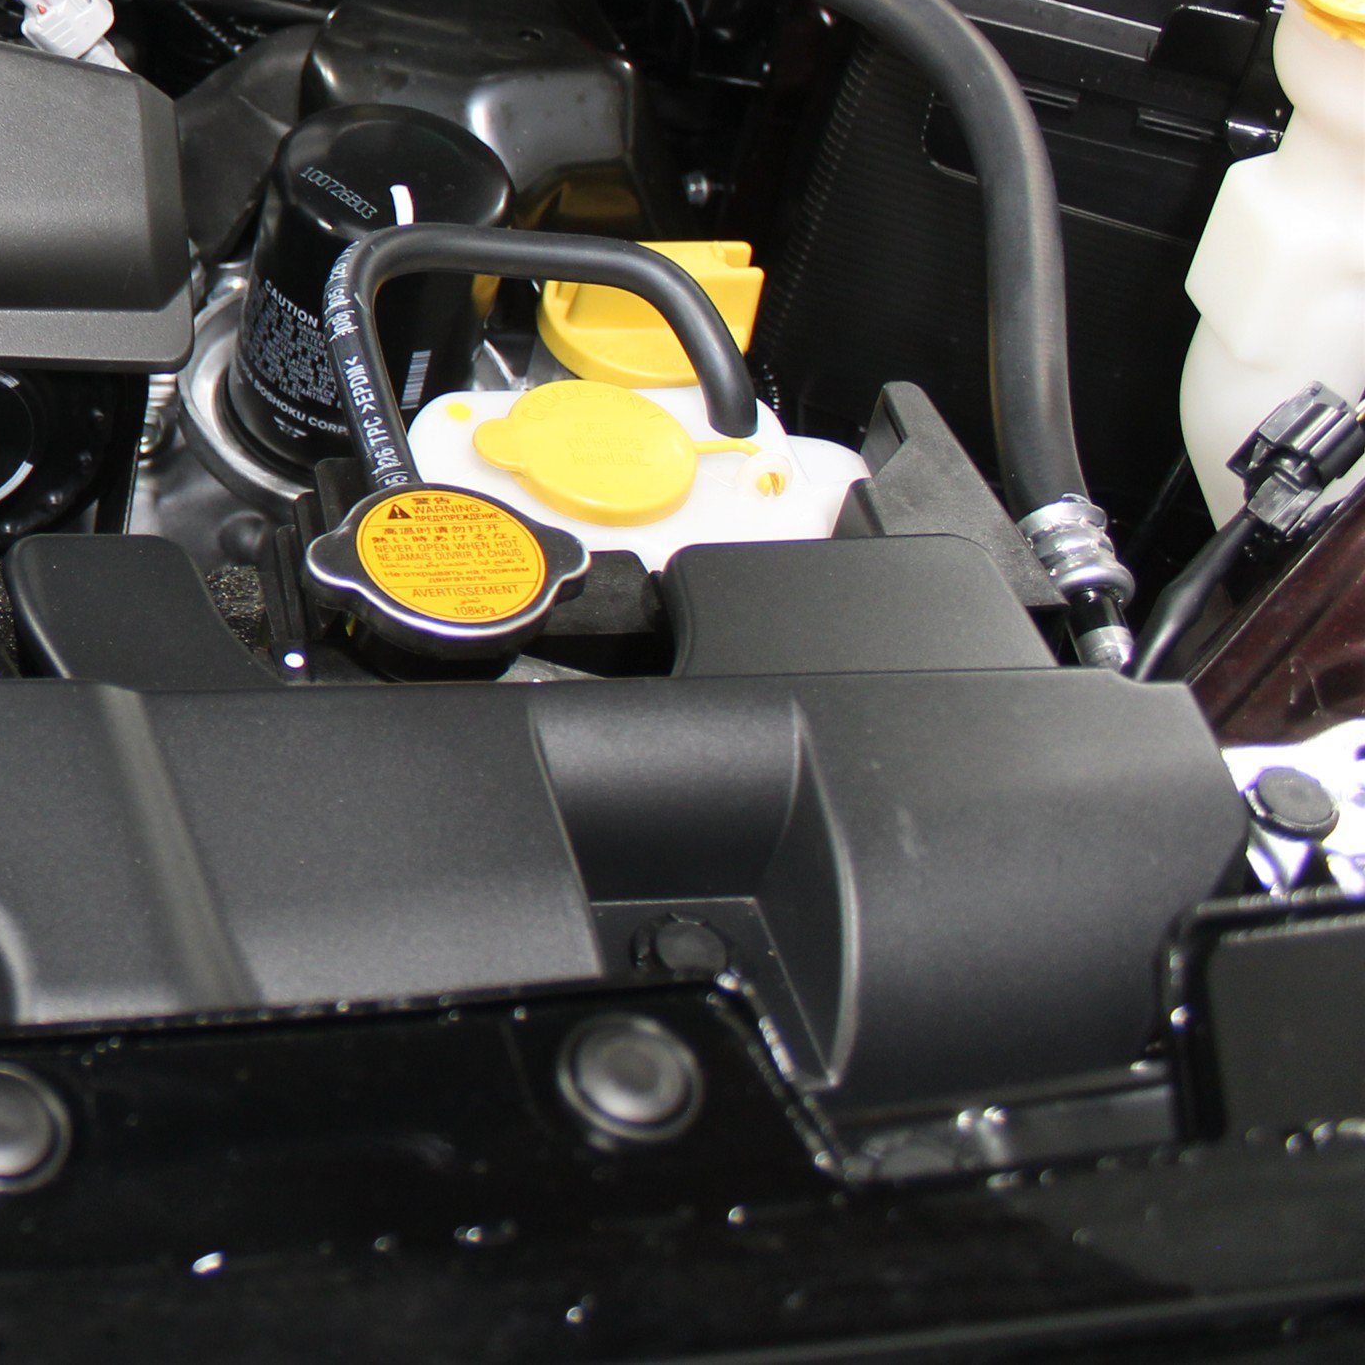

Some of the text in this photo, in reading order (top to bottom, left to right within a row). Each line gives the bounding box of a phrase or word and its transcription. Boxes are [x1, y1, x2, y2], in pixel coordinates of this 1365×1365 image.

[264, 279, 319, 329] CAUTION
[344, 355, 377, 414] >EPDM<
[253, 379, 306, 422] BOSHOKU
[363, 416, 389, 447] TPC
[412, 503, 481, 515] WARNING
[374, 544, 413, 554] NEVER
[418, 542, 450, 552] OPEN
[455, 540, 491, 551] WHEN
[377, 553, 392, 563] NE
[395, 552, 432, 562] JAMAIS
[435, 550, 471, 561] OUVRIR
[412, 584, 520, 598] AVERTISSEMENT
[453, 605, 497, 617] 108kPa
